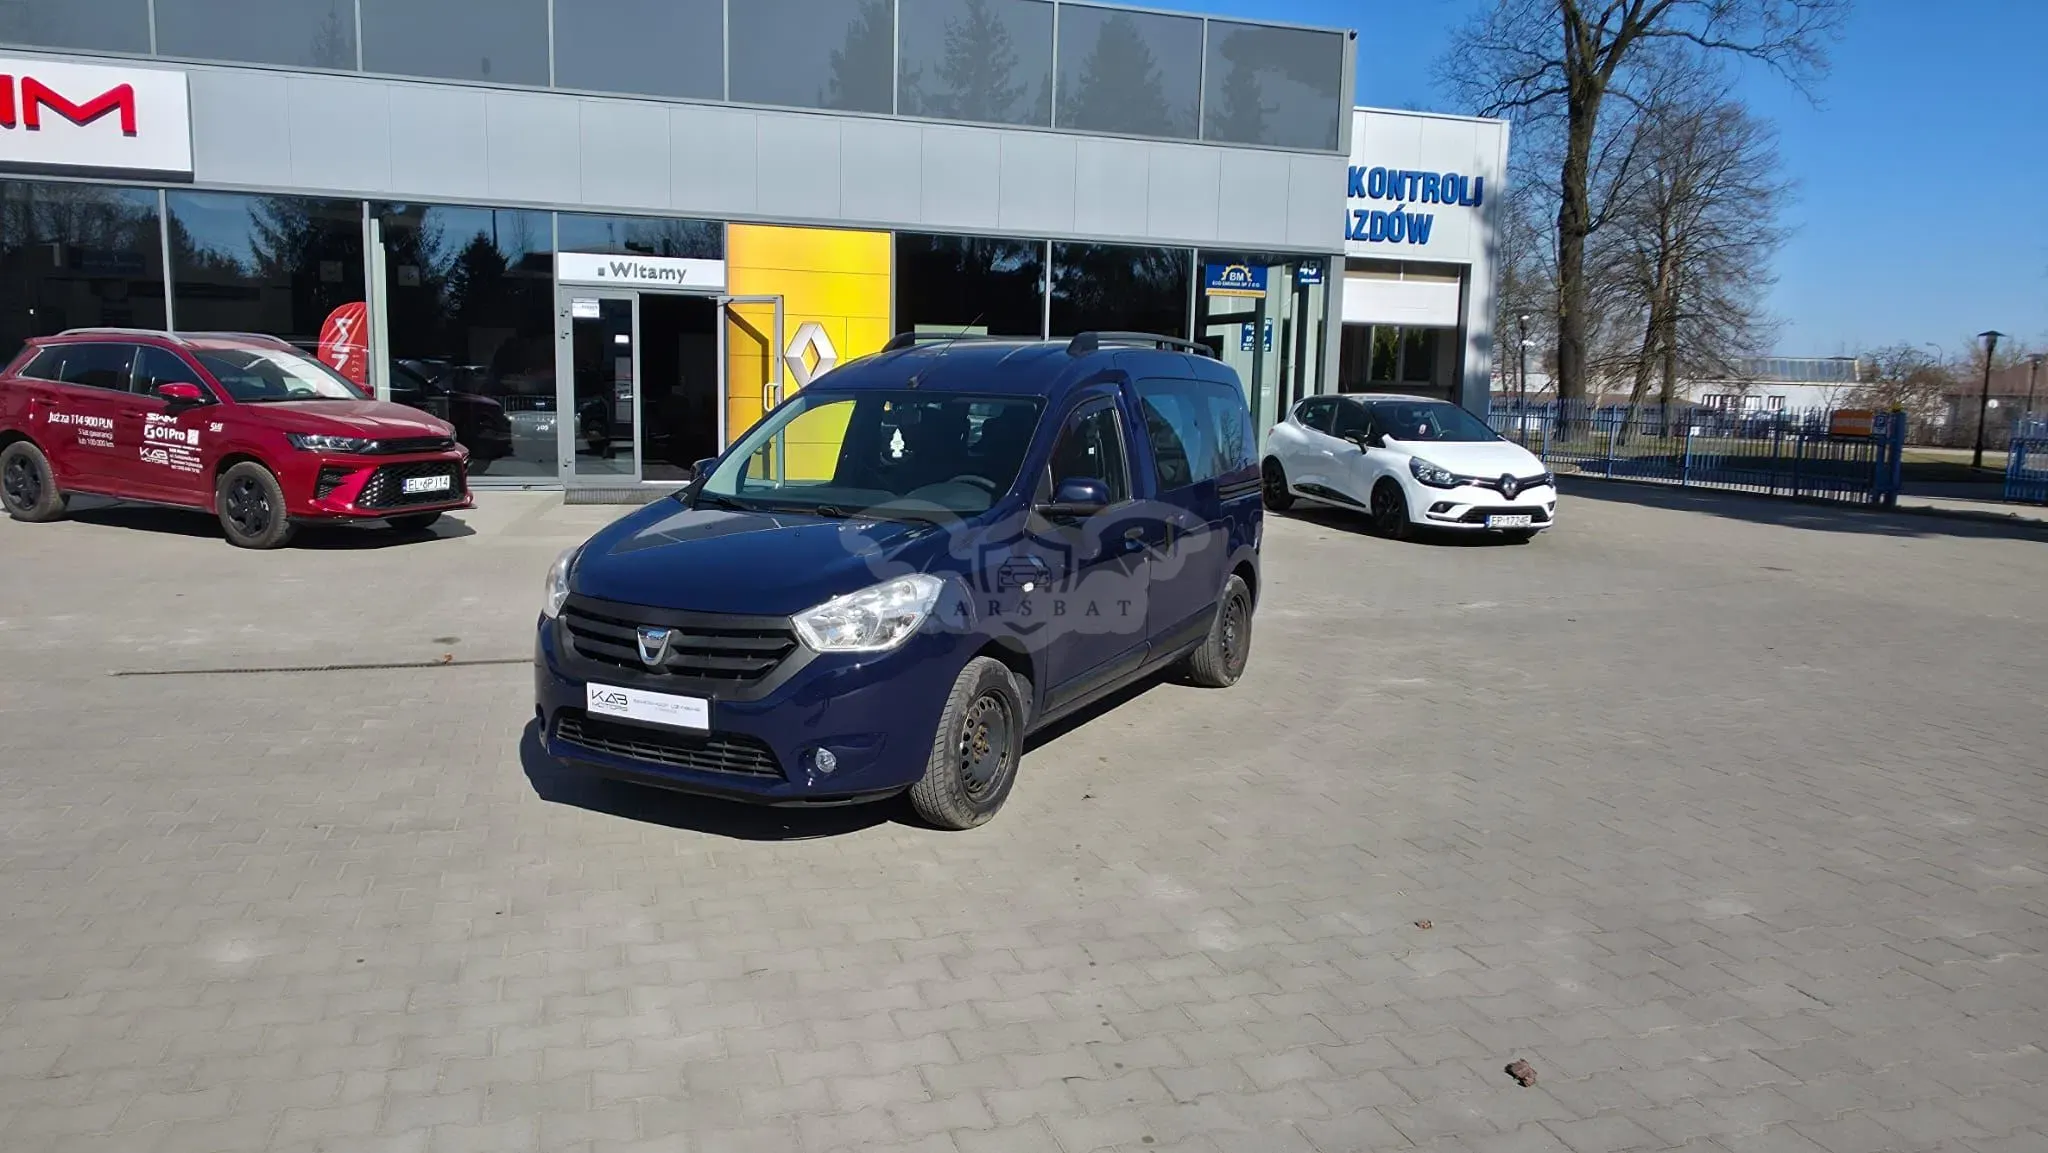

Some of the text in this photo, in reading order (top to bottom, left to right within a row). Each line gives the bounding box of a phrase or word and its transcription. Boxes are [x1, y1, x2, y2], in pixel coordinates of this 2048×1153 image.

[0, 75, 136, 137] M
[1348, 166, 1483, 207] KONTROLI
[609, 261, 687, 284] Witamy
[1229, 272, 1244, 281] BM
[48, 411, 60, 424] Już
[61, 414, 70, 424] za
[98, 417, 113, 429] PLN
[139, 446, 168, 460] KAB
[408, 480, 419, 490] EL
[591, 689, 628, 705] KAB
[592, 702, 628, 712] MOTORS
